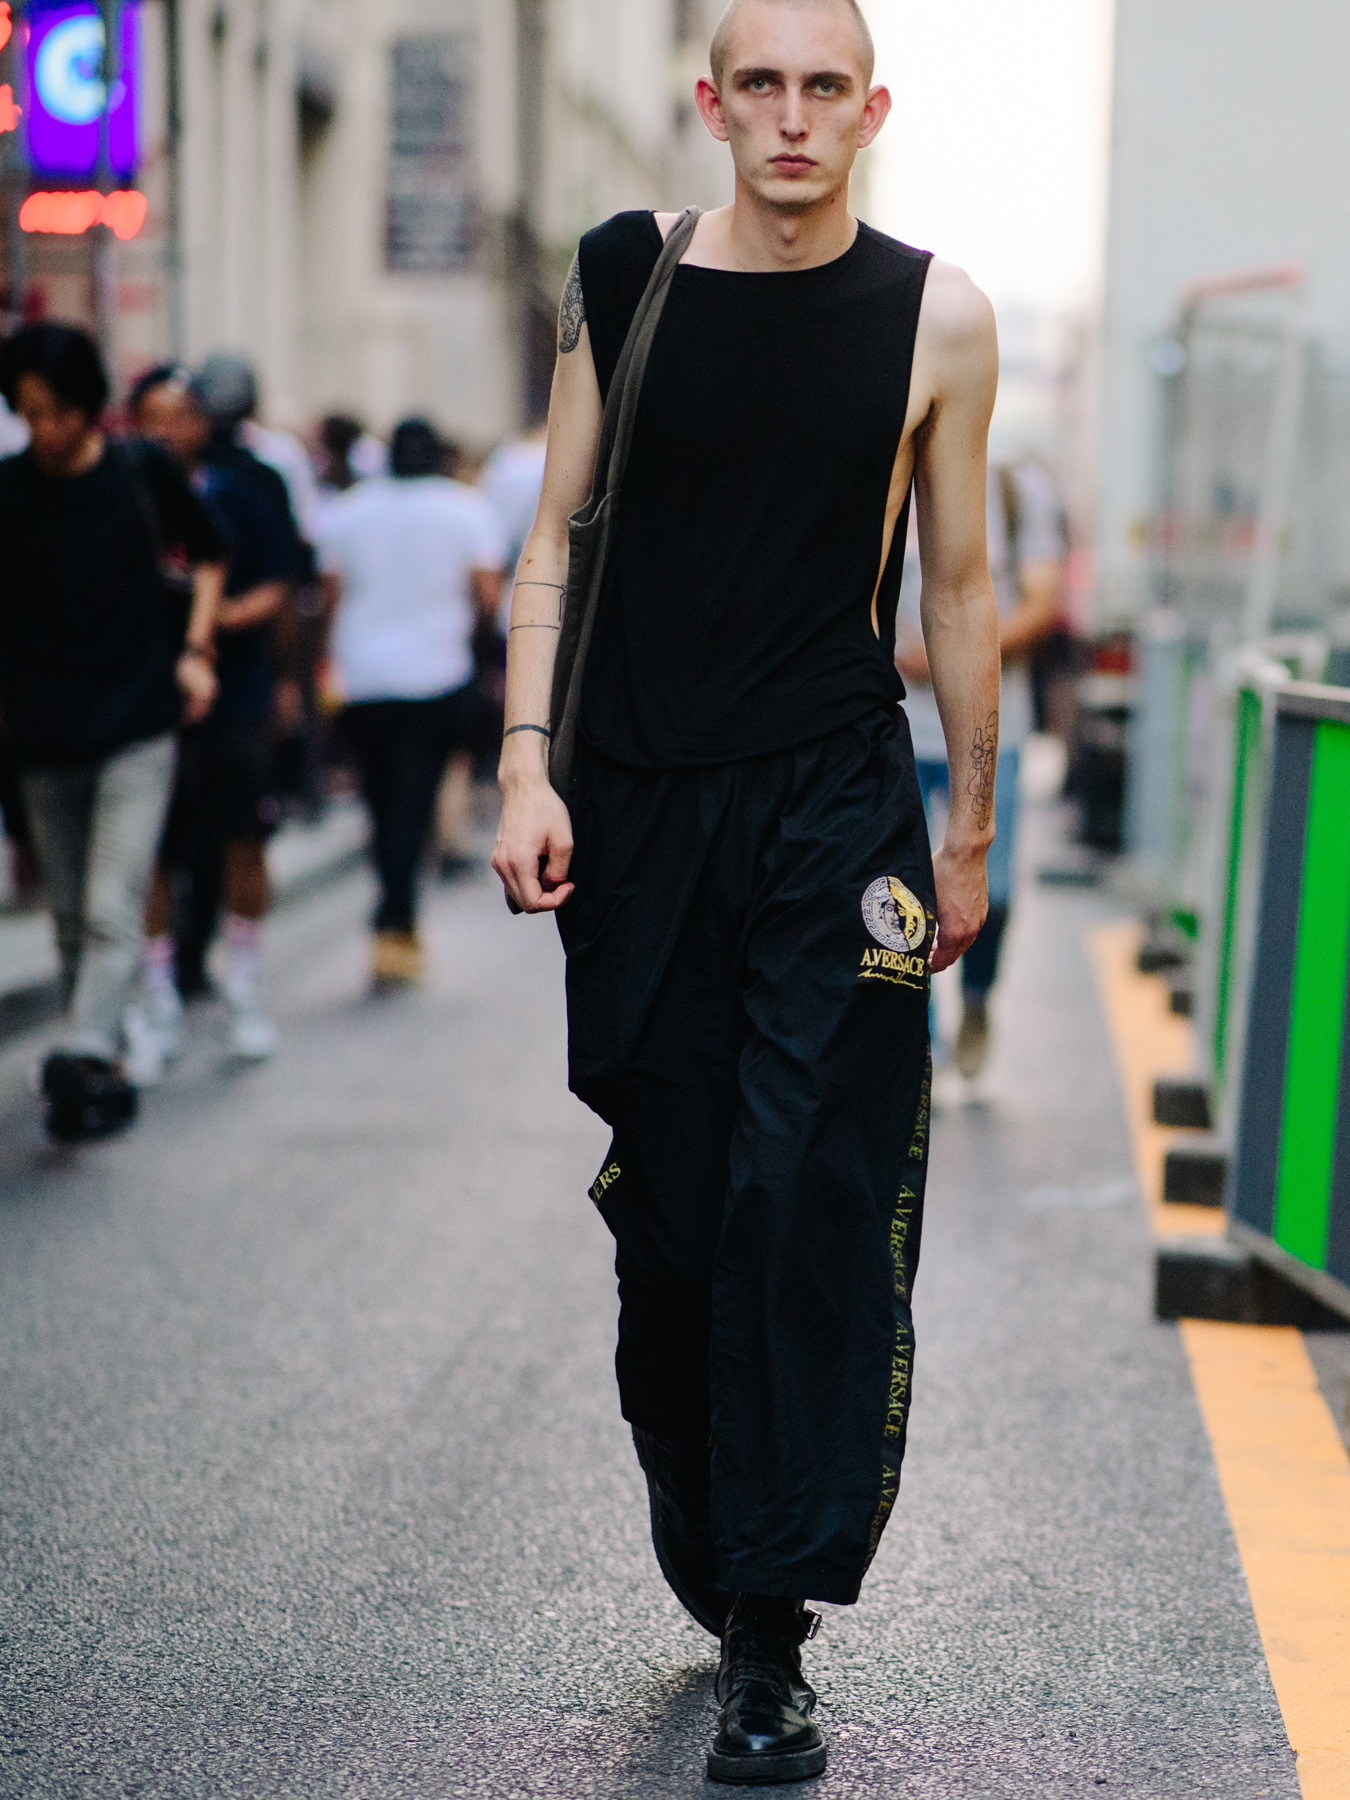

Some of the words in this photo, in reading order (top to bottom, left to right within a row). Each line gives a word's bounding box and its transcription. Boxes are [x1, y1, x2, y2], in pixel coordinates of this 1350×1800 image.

[860, 948, 925, 977] A.VERSACE
[889, 1184, 917, 1299] A.VERSACE
[884, 1320, 911, 1439] A.VERSACE
